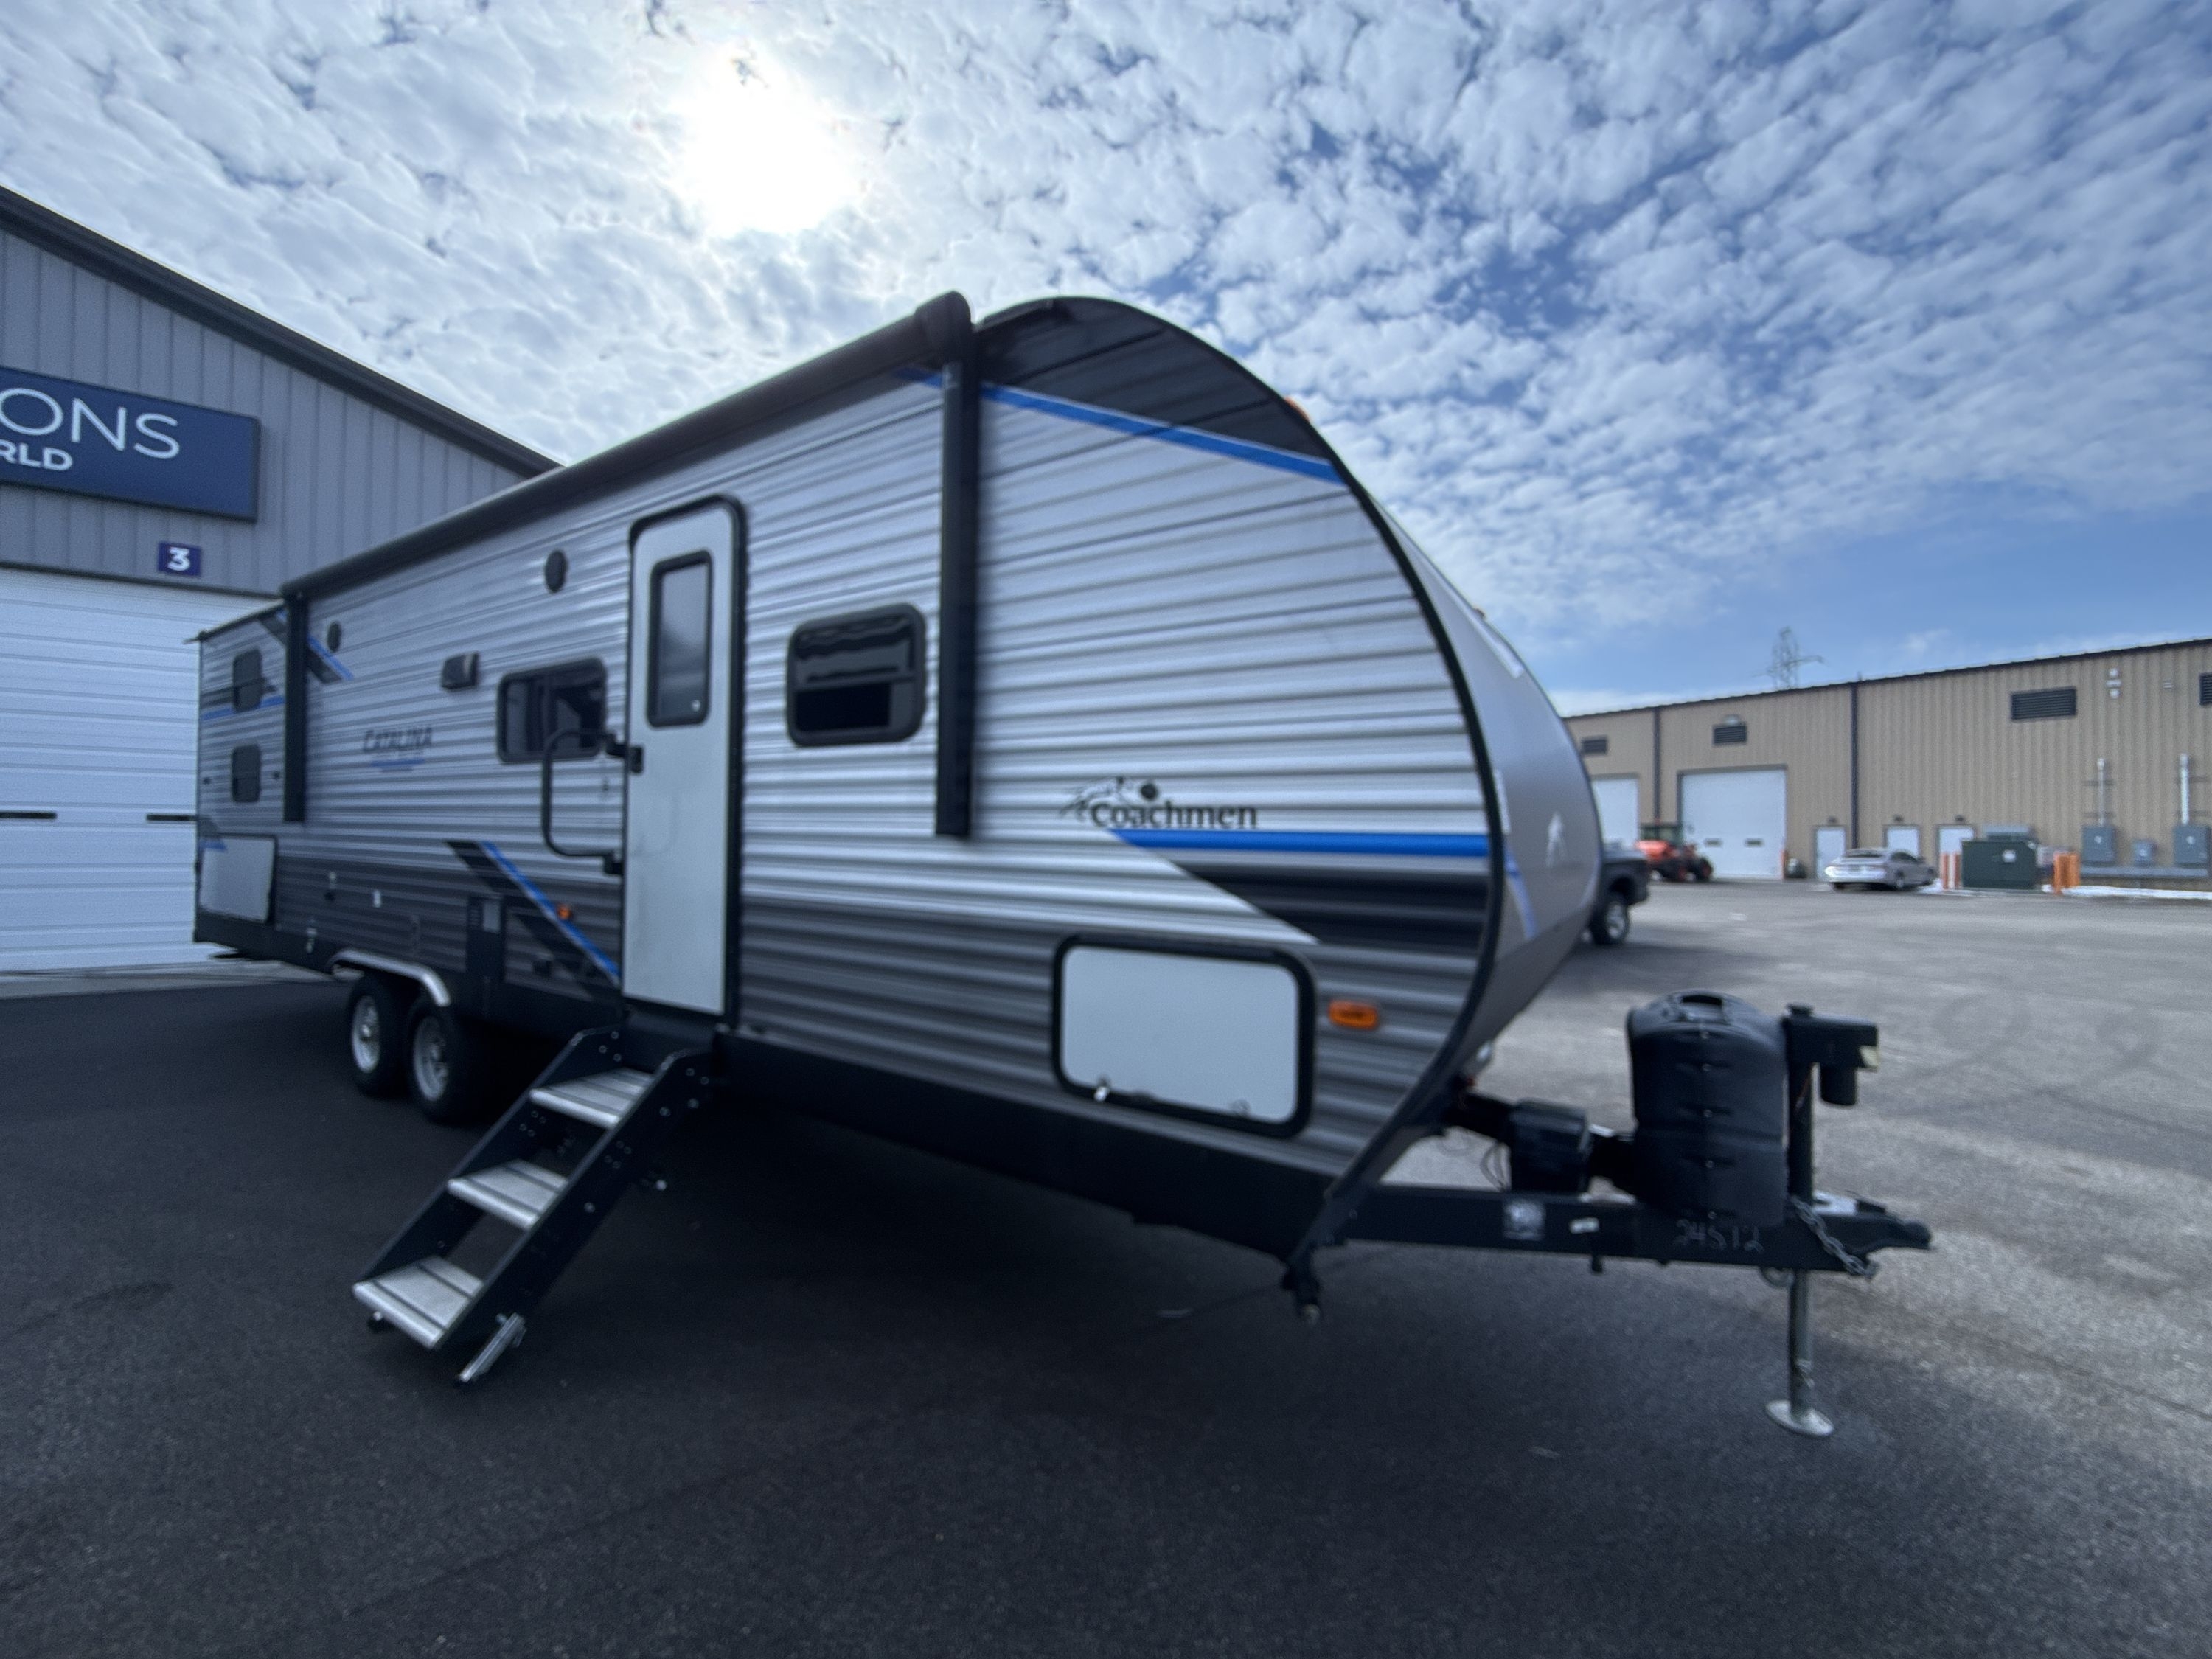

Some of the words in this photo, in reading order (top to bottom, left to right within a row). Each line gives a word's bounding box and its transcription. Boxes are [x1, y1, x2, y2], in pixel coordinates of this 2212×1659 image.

[0, 387, 180, 459] ONS
[167, 546, 191, 571] 3
[1091, 801, 1257, 829] Coachmen
